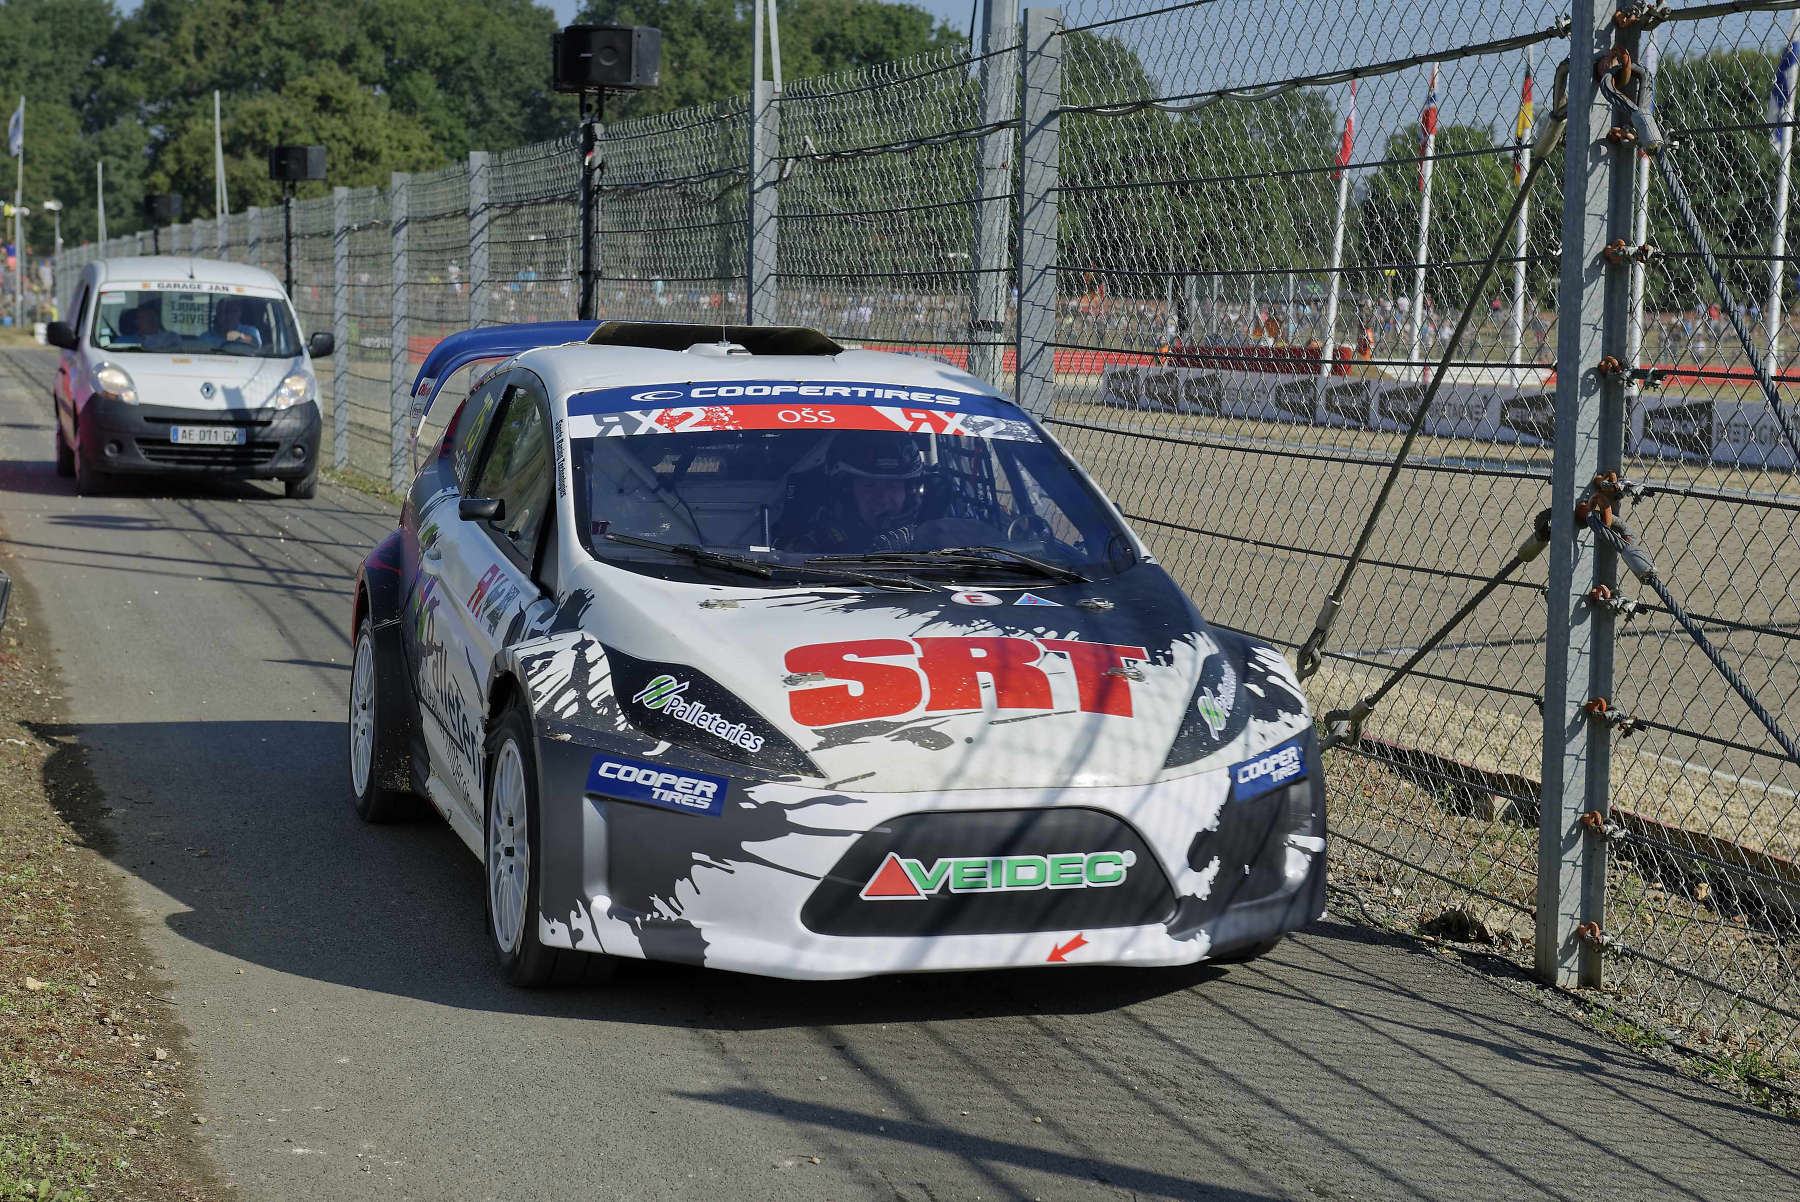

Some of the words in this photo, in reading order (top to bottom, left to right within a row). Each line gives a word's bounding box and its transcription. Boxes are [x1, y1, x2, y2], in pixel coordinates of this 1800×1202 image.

[157, 282, 201, 290] GARAGE
[777, 407, 835, 424] OŠS
[182, 429, 196, 441] AE
[785, 637, 1149, 727] SRT
[663, 695, 765, 753] Palleteries
[598, 761, 718, 799] COOPER
[1237, 746, 1300, 784] COOPER
[1272, 761, 1301, 783] TIRES
[652, 787, 713, 810] TIRES
[904, 853, 1125, 892] VEIDEC
